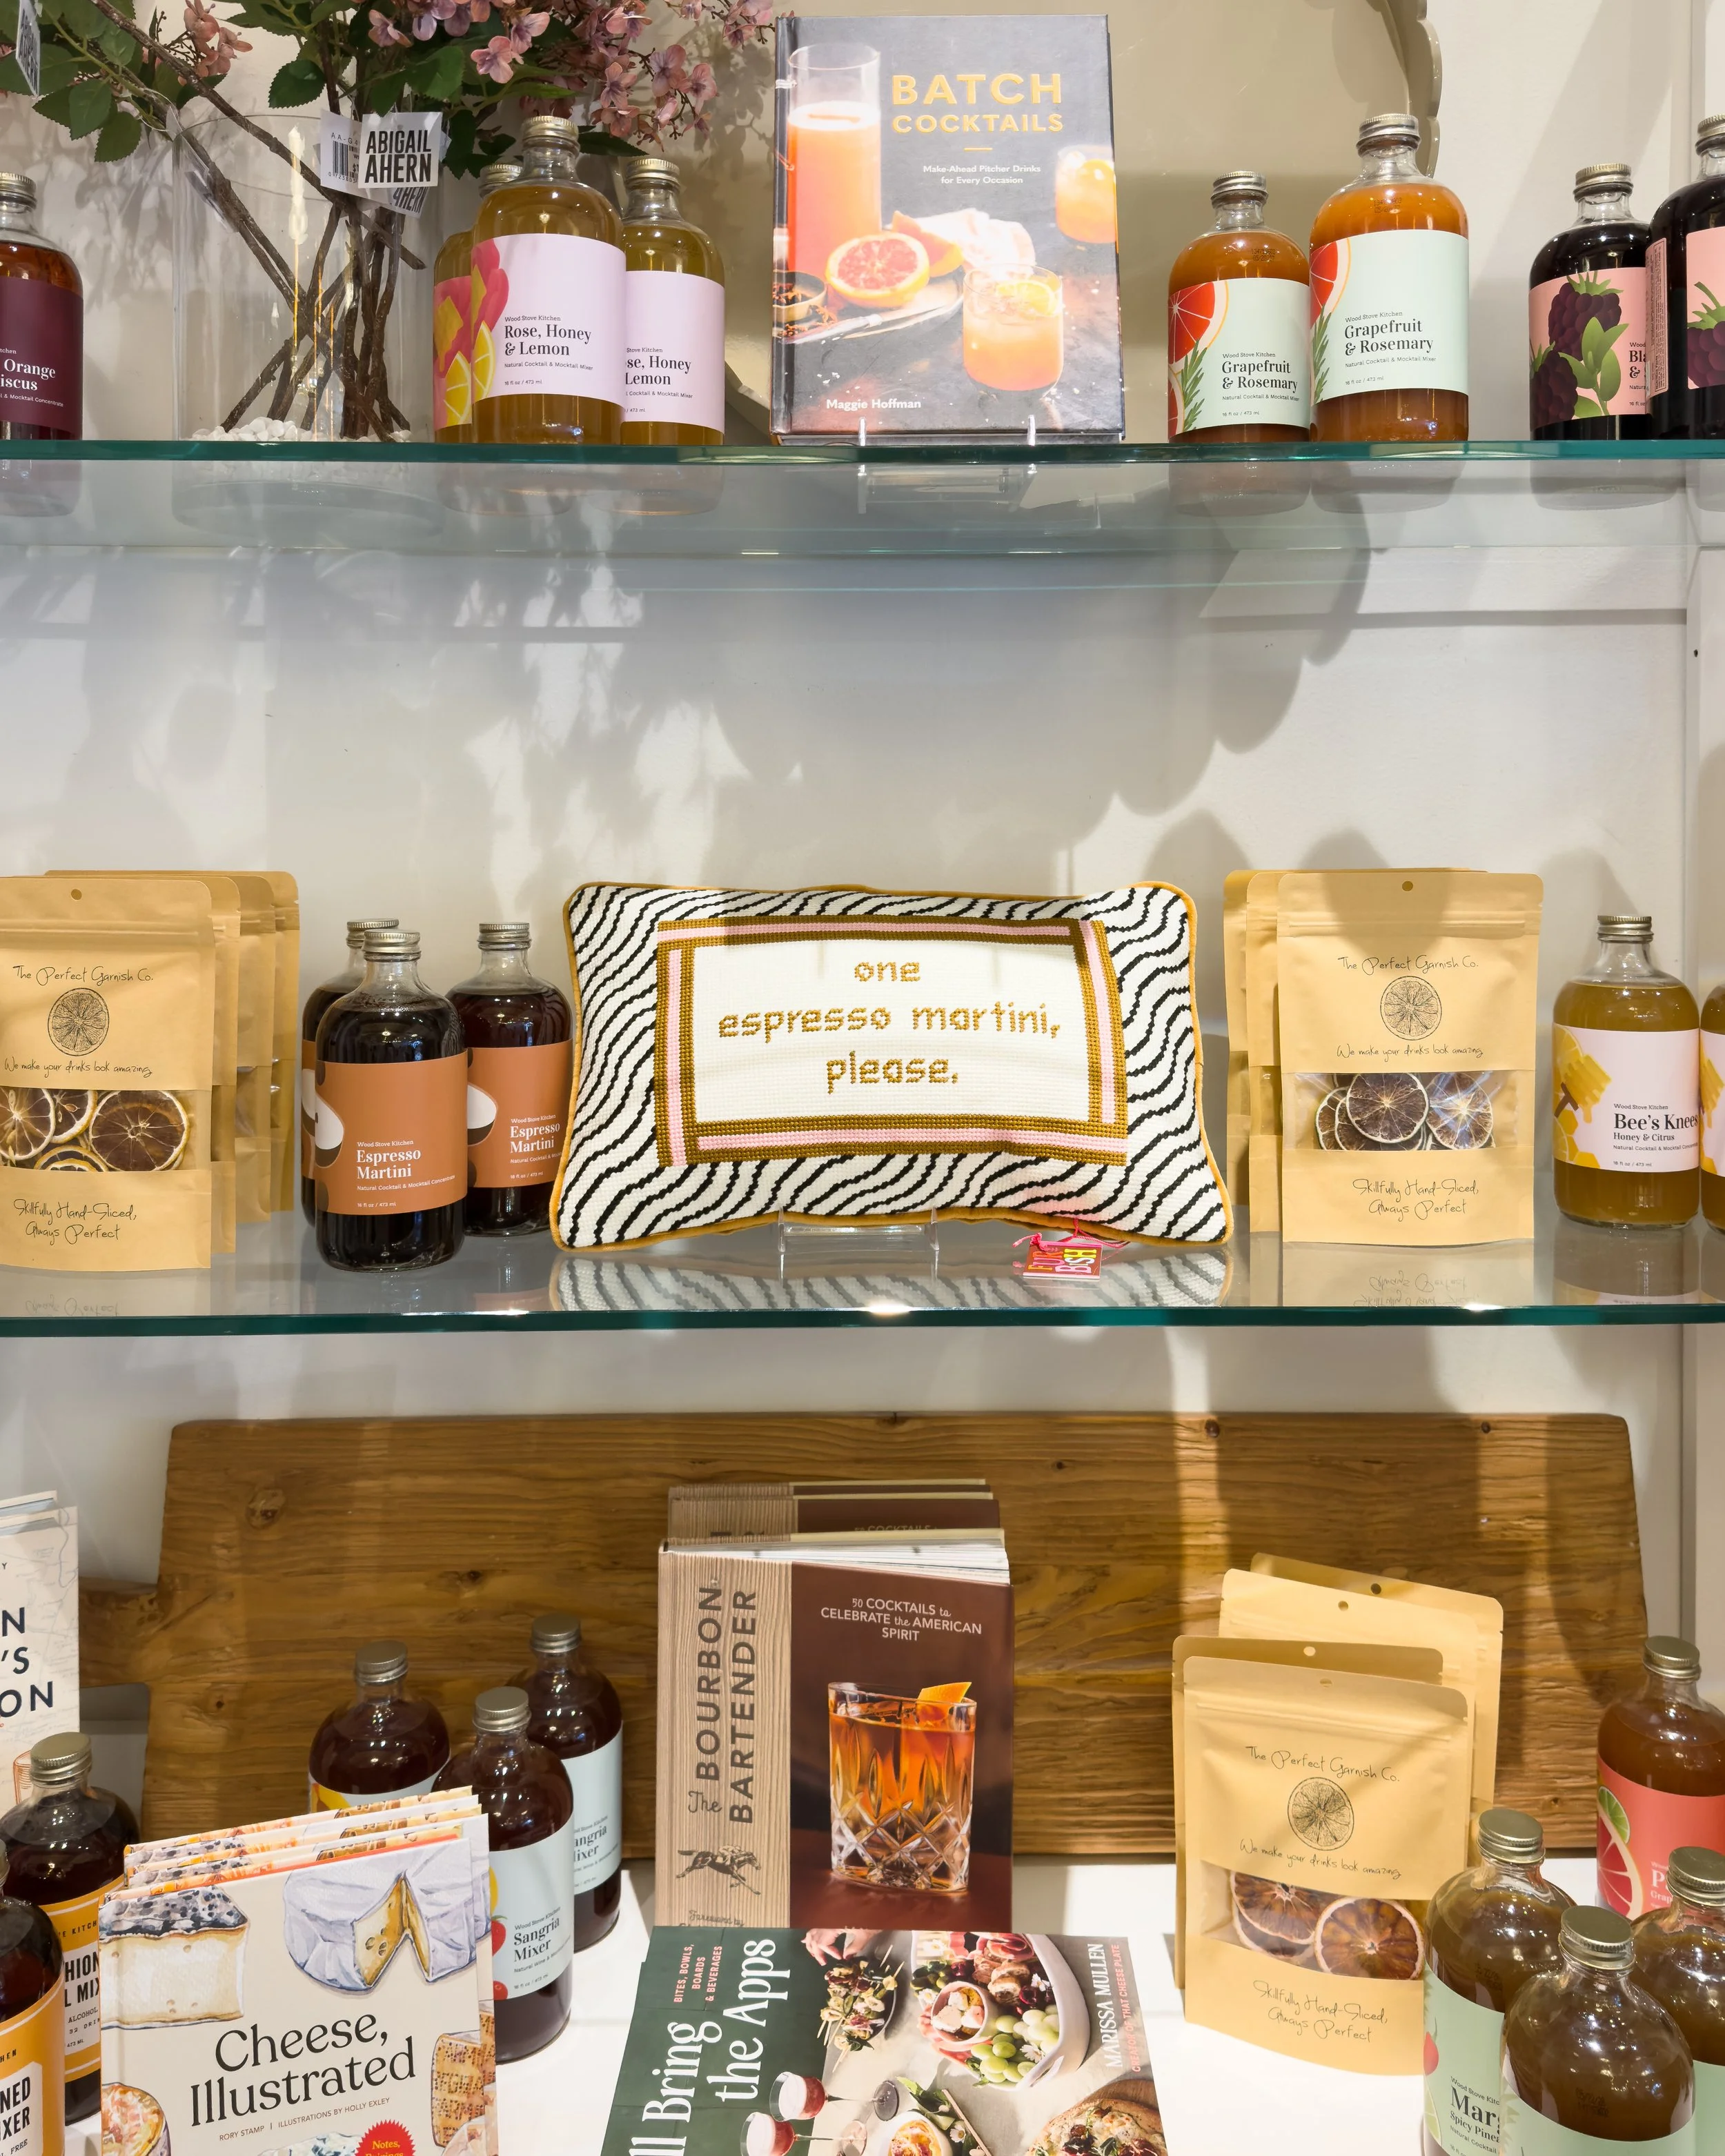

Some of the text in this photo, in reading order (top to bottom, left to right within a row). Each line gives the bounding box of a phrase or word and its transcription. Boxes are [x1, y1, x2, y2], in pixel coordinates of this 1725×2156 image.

[892, 73, 1061, 105] BATCH
[892, 114, 1064, 133] COCKTAILS
[366, 130, 431, 154] ABIGAIL
[364, 154, 431, 183] AHERN
[956, 177, 980, 186] Every
[505, 324, 591, 344] Rose, Honey
[1345, 319, 1423, 339] Grapefruit
[505, 342, 570, 356] & Lemon
[1346, 339, 1433, 356] & Rosemary
[4, 359, 55, 380] Orange
[627, 355, 691, 374] se, Honey
[1222, 360, 1291, 375] Grapefruit
[0, 374, 37, 390] iscus
[625, 373, 671, 384] Lemon
[1223, 377, 1297, 393] & Rosemary
[35, 397, 63, 407] Concentrate
[827, 398, 921, 411] Maggie Hoffman
[13, 965, 153, 986] The Perfect Garnish Co.
[854, 961, 920, 982] one
[1338, 955, 1478, 976] The Perfect Garnish Co.
[718, 1001, 1060, 1043] espresso martini,
[1337, 1043, 1354, 1058] We
[1359, 1045, 1379, 1055] make
[1383, 1049, 1399, 1062] your
[1404, 1045, 1429, 1056] drinks
[1433, 1044, 1448, 1053] look
[5, 1056, 19, 1072] We
[21, 1059, 39, 1069] make
[44, 1065, 61, 1078] your
[66, 1060, 90, 1073] drinks
[95, 1062, 109, 1071] look
[511, 1123, 560, 1140] Espresso
[1664, 1114, 1698, 1129] Knees
[511, 1136, 554, 1154] Martini
[1614, 1133, 1640, 1143] Honey
[357, 1149, 421, 1166] Espresso
[357, 1164, 412, 1179] Martini
[1352, 1178, 1479, 1203] Skillfully Hand-Sliced,
[14, 1199, 137, 1225] Skillfully Hand-Sliced,
[1369, 1199, 1467, 1222] Always Perfect
[26, 1221, 120, 1245] Always Perfect
[1028, 1252, 1064, 1270] FUR
[852, 1599, 952, 1617] 50 COCKTAILS to
[821, 1608, 981, 1634] CELEBRATE the AMERICAN
[882, 1628, 919, 1641] SPIRIT
[696, 1588, 722, 1781] BOURBON
[729, 1591, 756, 1823] BARTENDER
[1245, 1745, 1399, 1781] The Perfect Garnish Co.
[689, 1790, 722, 1812] The
[1240, 1838, 1257, 1854] We
[1261, 1846, 1282, 1858] make
[1287, 1855, 1305, 1868] your
[1310, 1854, 1337, 1867] drinks
[1341, 1860, 1358, 1870] look
[514, 1918, 559, 1941] Sangria
[514, 1939, 551, 1961] Mixer
[680, 1943, 694, 1974] BOWLS,
[692, 1957, 705, 1989] BOARDS
[707, 1946, 722, 1992] BEVERAGES
[673, 1977, 688, 2003] BITES,
[1087, 1944, 1123, 2068] MARISSA MULLEN
[1112, 1944, 1141, 2073] CREATOR OF THAT CHEESE PLATE
[1253, 1980, 1388, 2024] Skillfully Hand-Sliced,
[68, 2007, 98, 2024] ALCOHOL
[707, 1939, 790, 2102] the Apps
[1268, 2006, 1372, 2042] Always Perfect
[215, 2014, 387, 2072] Cheese,
[190, 2035, 416, 2126] Illustrated
[642, 2021, 722, 2122] Bring
[1450, 2076, 1485, 2100] Wood Stove
[278, 2111, 331, 2128] ILLUSTRATIONS
[344, 2102, 366, 2113] HOLLY
[369, 2097, 390, 2107] EXLEY
[1450, 2111, 1472, 2133] Spicy
[219, 2126, 264, 2140] RORY STAMP
[11, 2139, 28, 2155] FREE
[372, 2140, 400, 2150] Notes,
